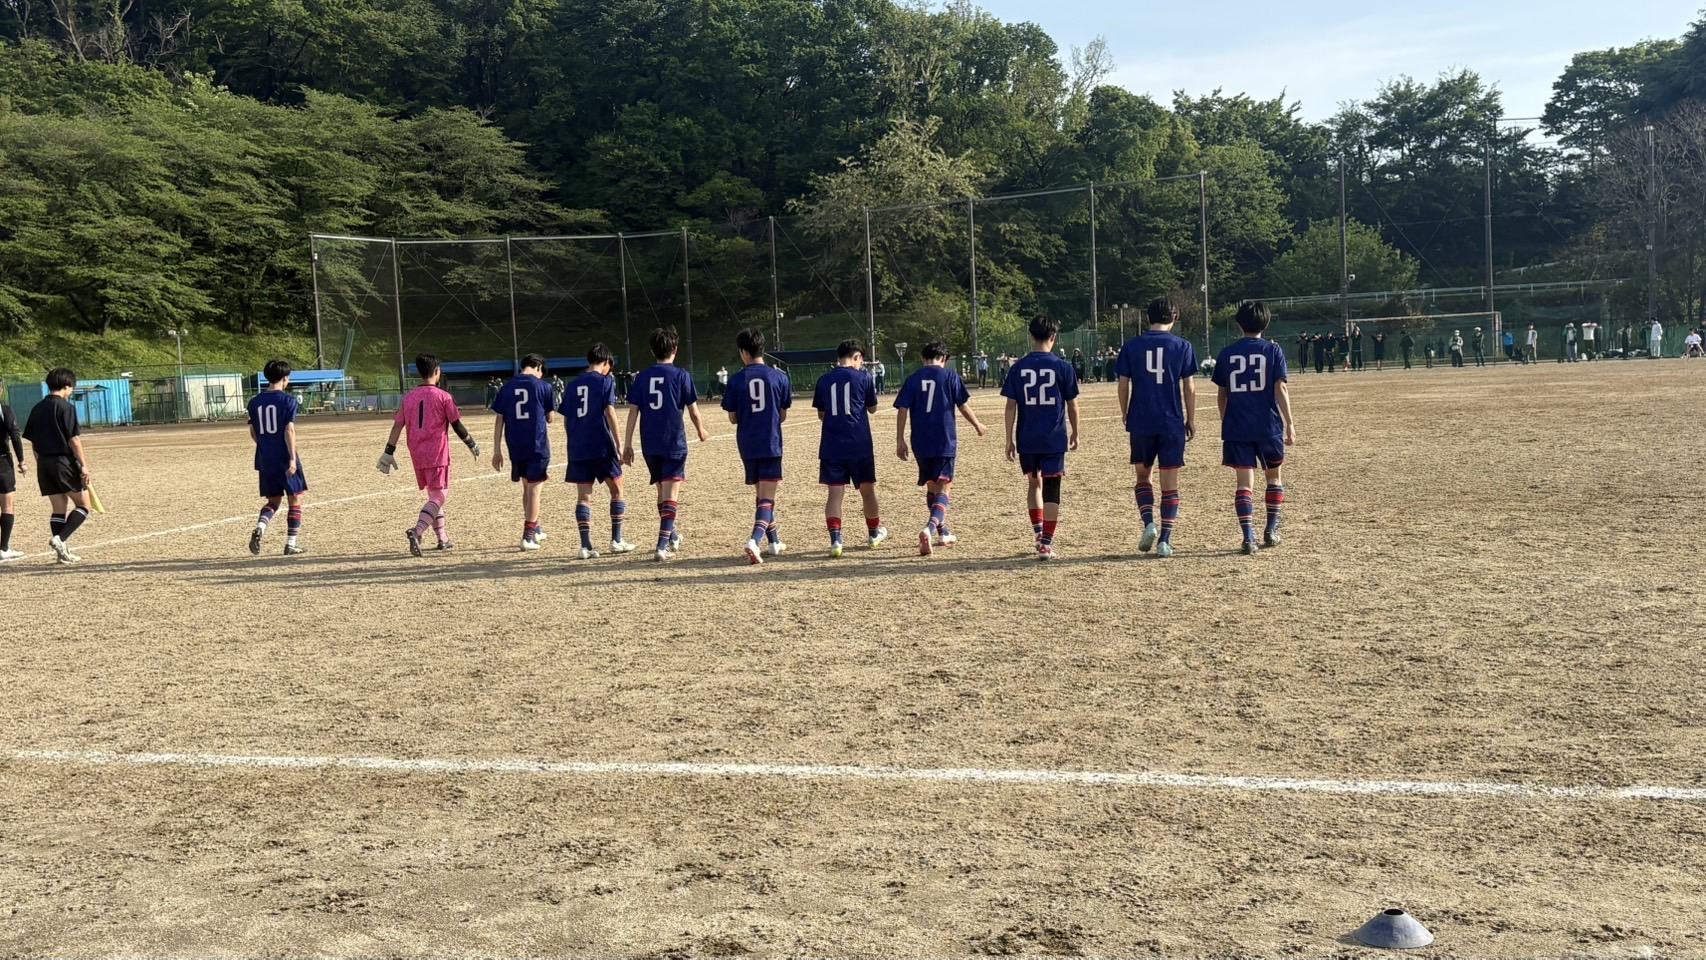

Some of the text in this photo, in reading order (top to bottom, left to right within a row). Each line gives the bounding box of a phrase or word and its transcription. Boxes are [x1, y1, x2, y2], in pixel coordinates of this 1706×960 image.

[1146, 347, 1165, 385] 4
[1229, 353, 1267, 392] 23
[576, 385, 589, 418] 3
[649, 376, 665, 409] 5
[748, 378, 766, 412] 9
[830, 381, 852, 415] 11
[921, 379, 936, 412] 7
[1020, 368, 1056, 406] 22
[257, 404, 279, 435] 10
[418, 399, 424, 429] 1
[514, 388, 530, 420] 2
